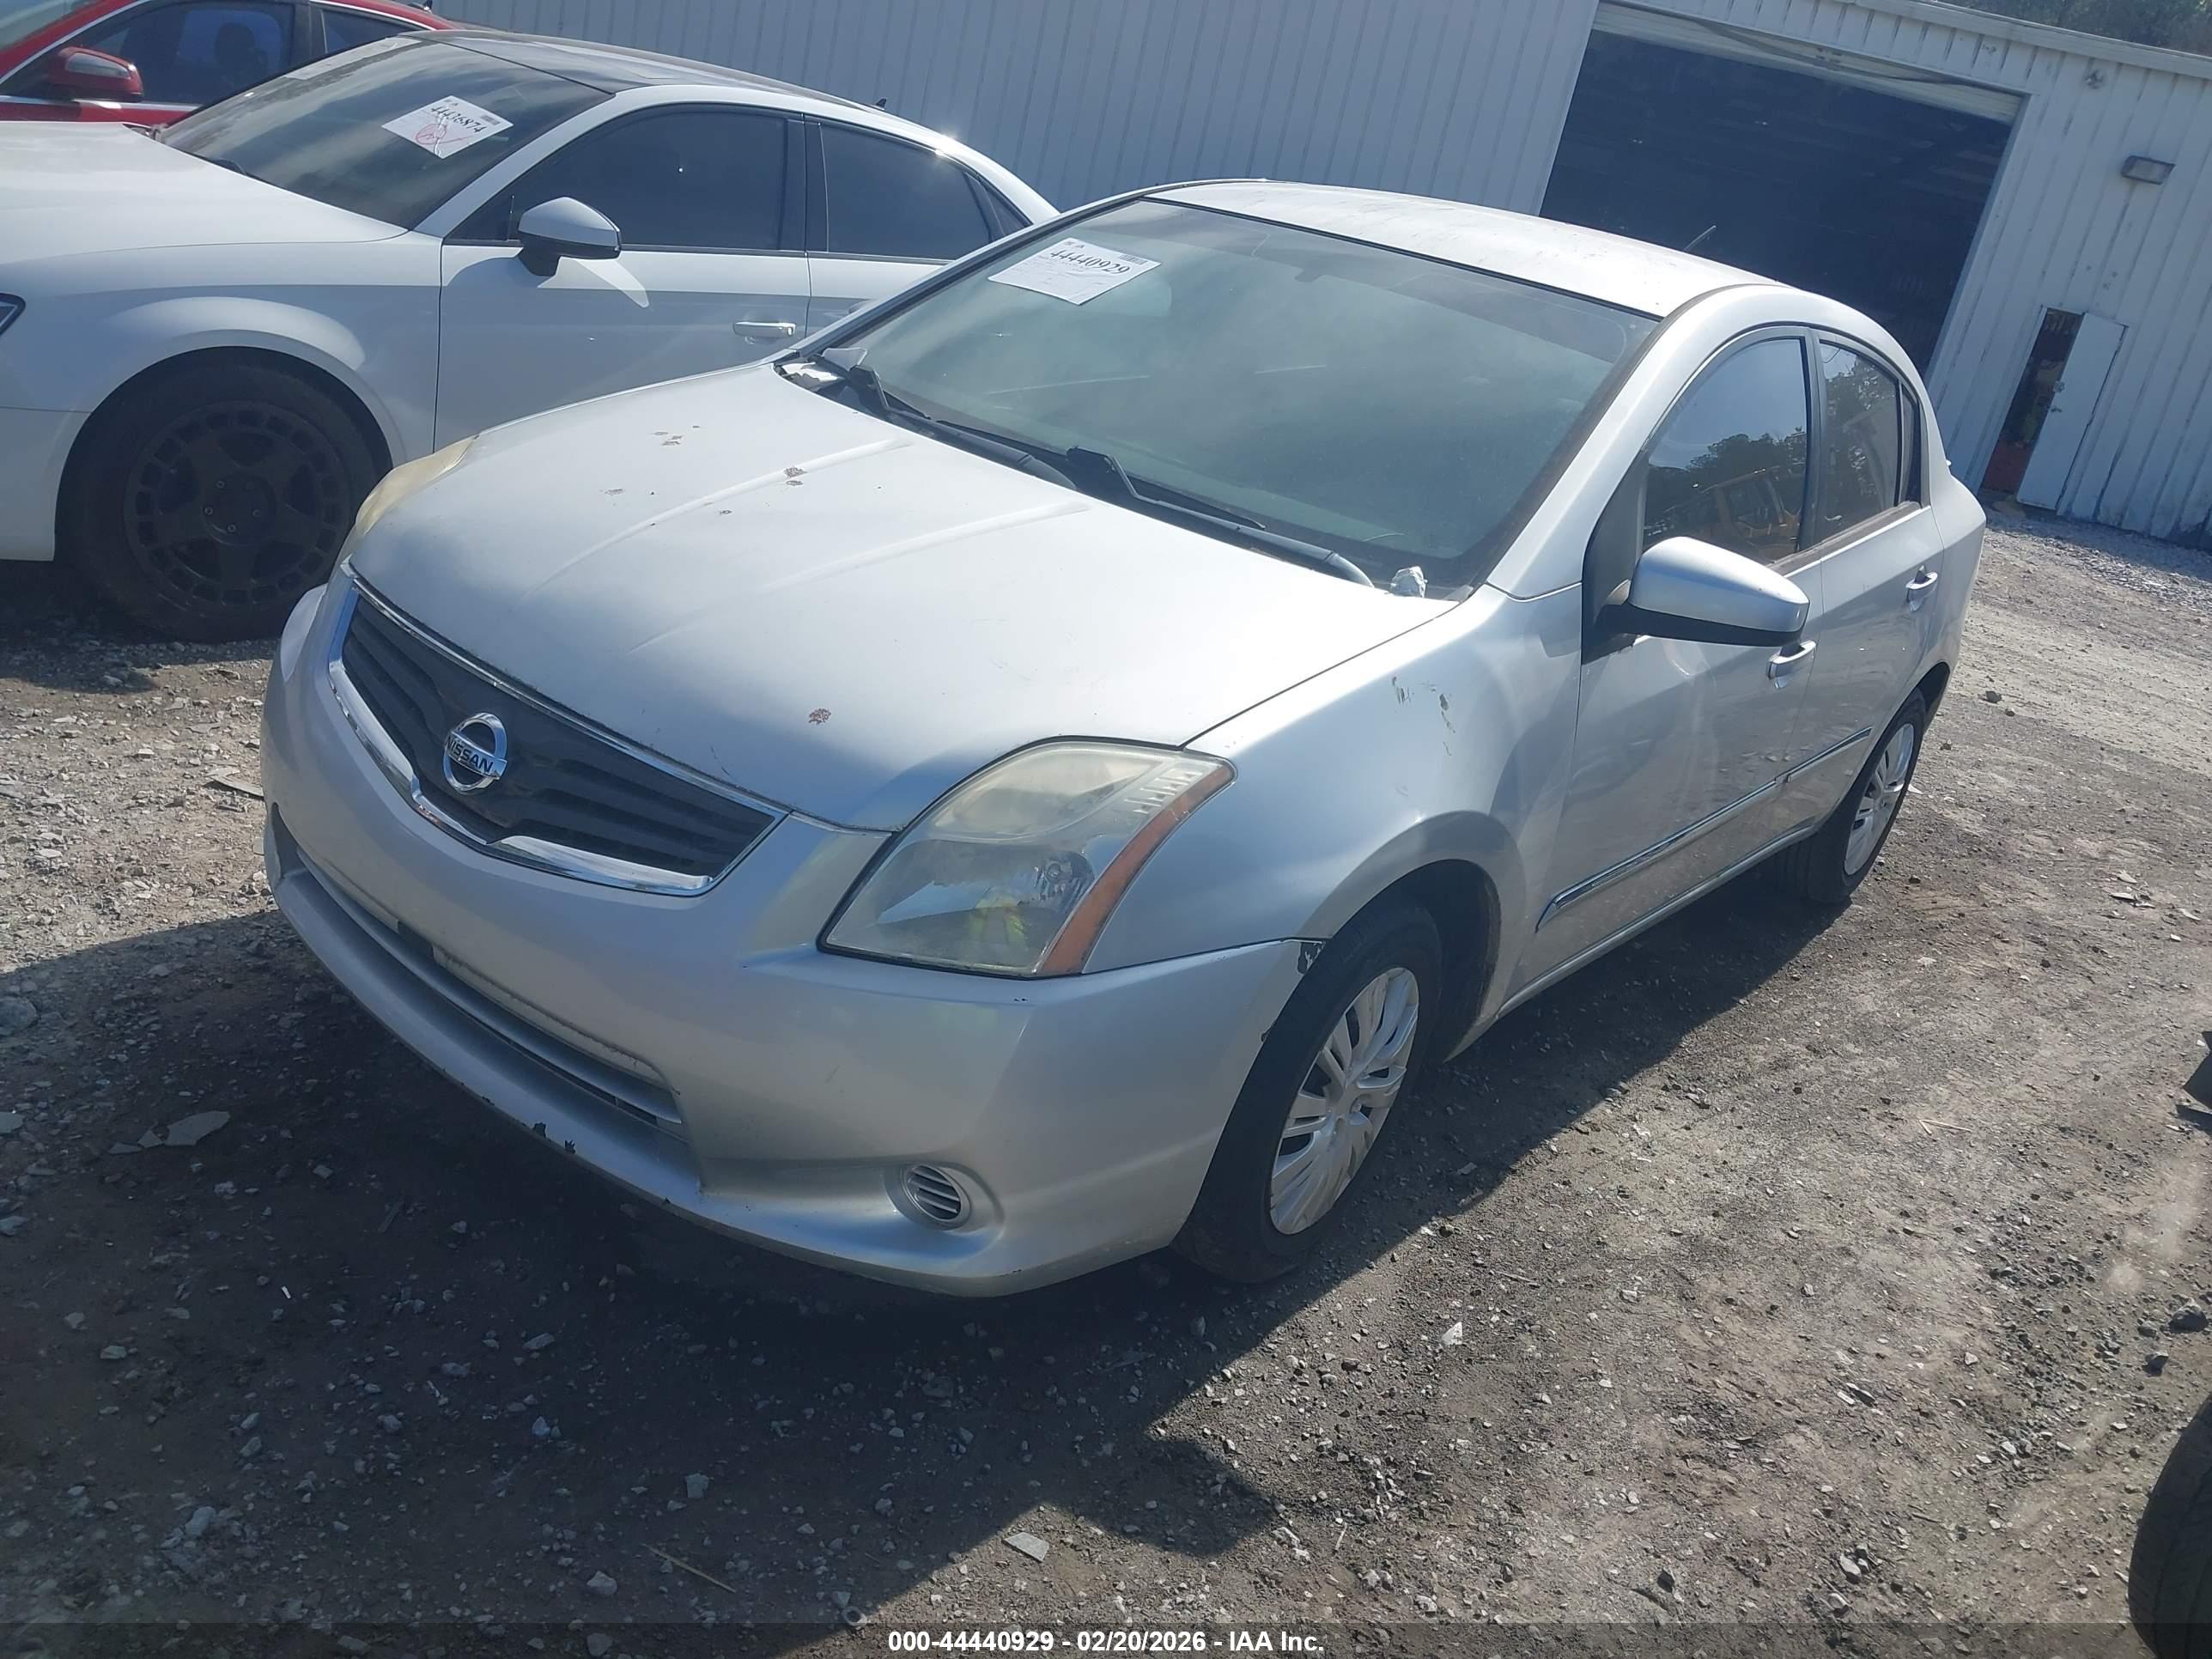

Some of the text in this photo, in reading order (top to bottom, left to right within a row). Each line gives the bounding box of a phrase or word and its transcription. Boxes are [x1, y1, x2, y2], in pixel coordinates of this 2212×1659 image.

[430, 106, 488, 133] 44436874
[1049, 249, 1132, 275] 44440929
[446, 735, 494, 774] NISSAN
